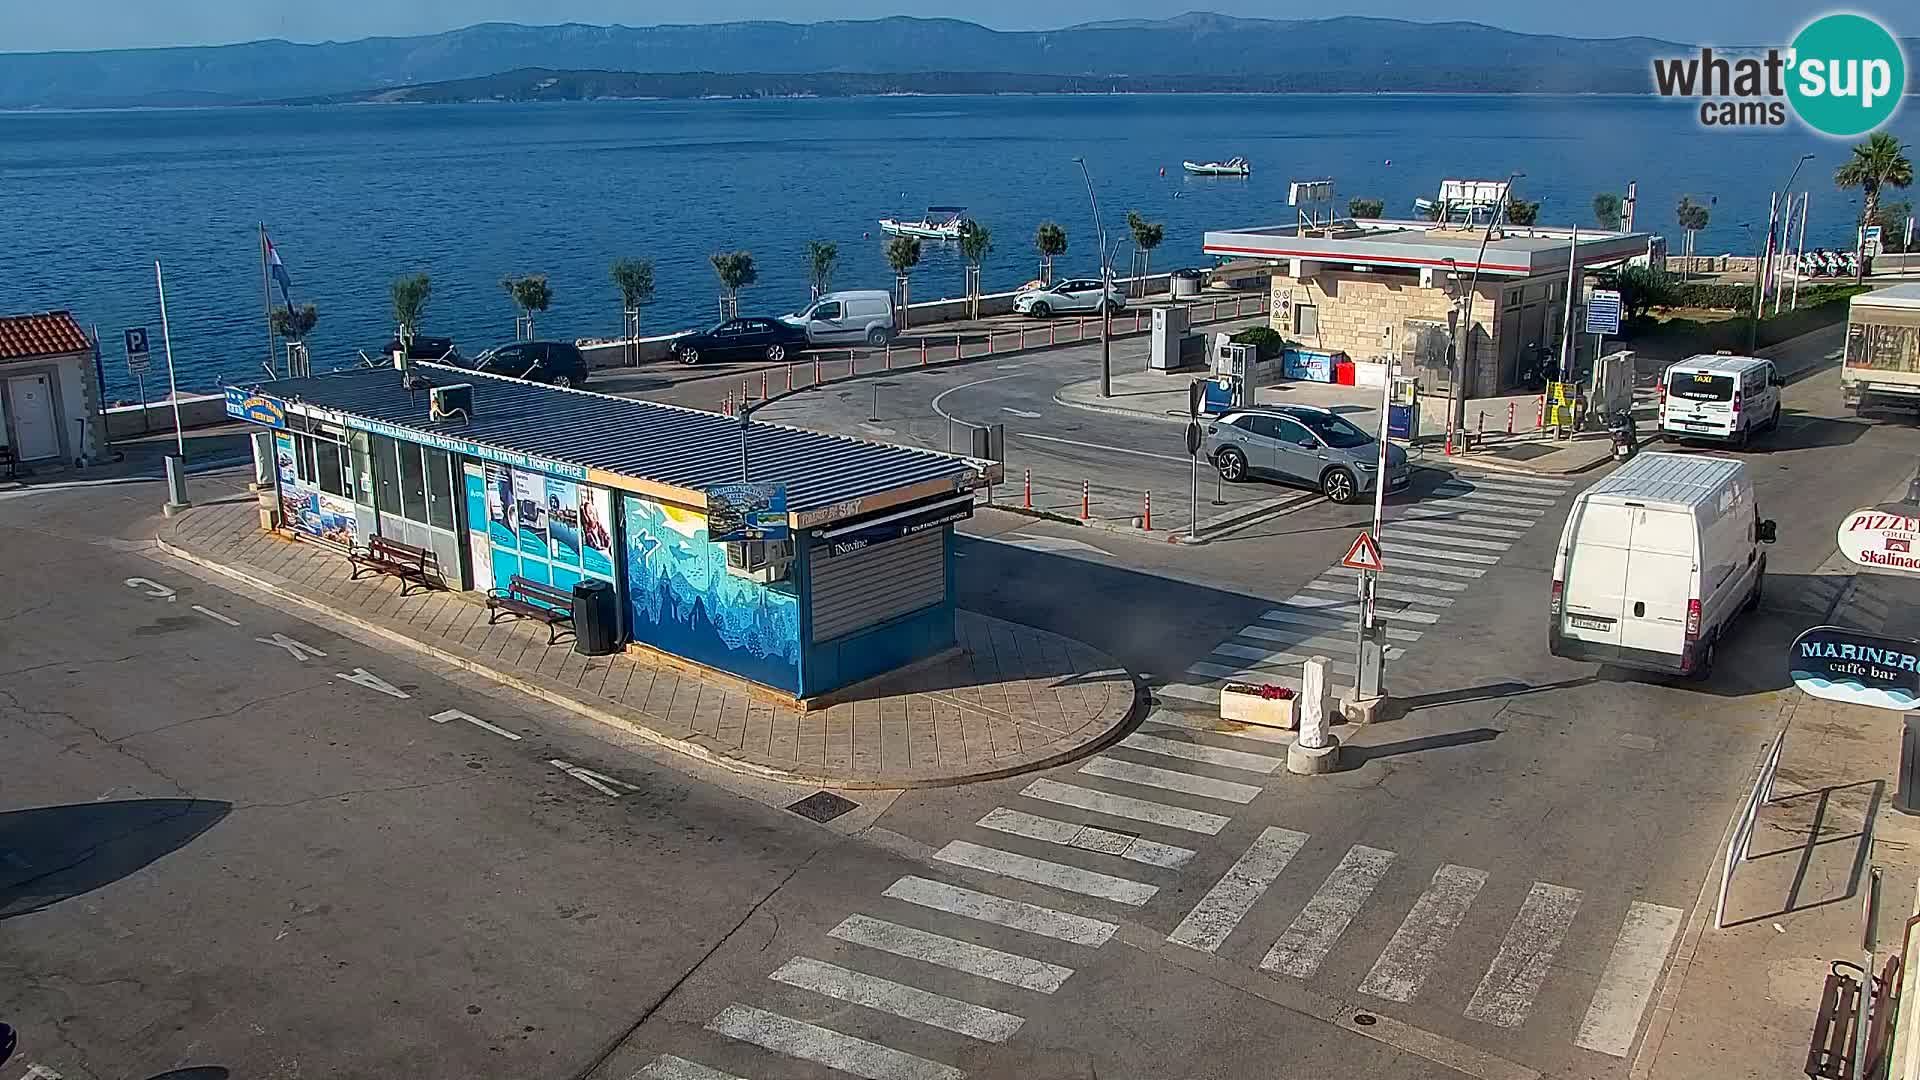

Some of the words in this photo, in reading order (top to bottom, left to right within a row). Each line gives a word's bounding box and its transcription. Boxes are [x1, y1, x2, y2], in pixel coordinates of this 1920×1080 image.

[1693, 375, 1713, 384] TAXI
[436, 437, 468, 453] POSTAJA
[493, 449, 526, 466] STATION
[527, 456, 554, 472] TICKET
[555, 463, 583, 478] OFFICE
[1848, 515, 1920, 533] PIZZE
[1882, 530, 1917, 540] GRILL
[834, 537, 868, 556] iNovine
[1800, 642, 1920, 674] MARINER
[1829, 662, 1866, 676] caffe
[1871, 665, 1897, 681] bar
